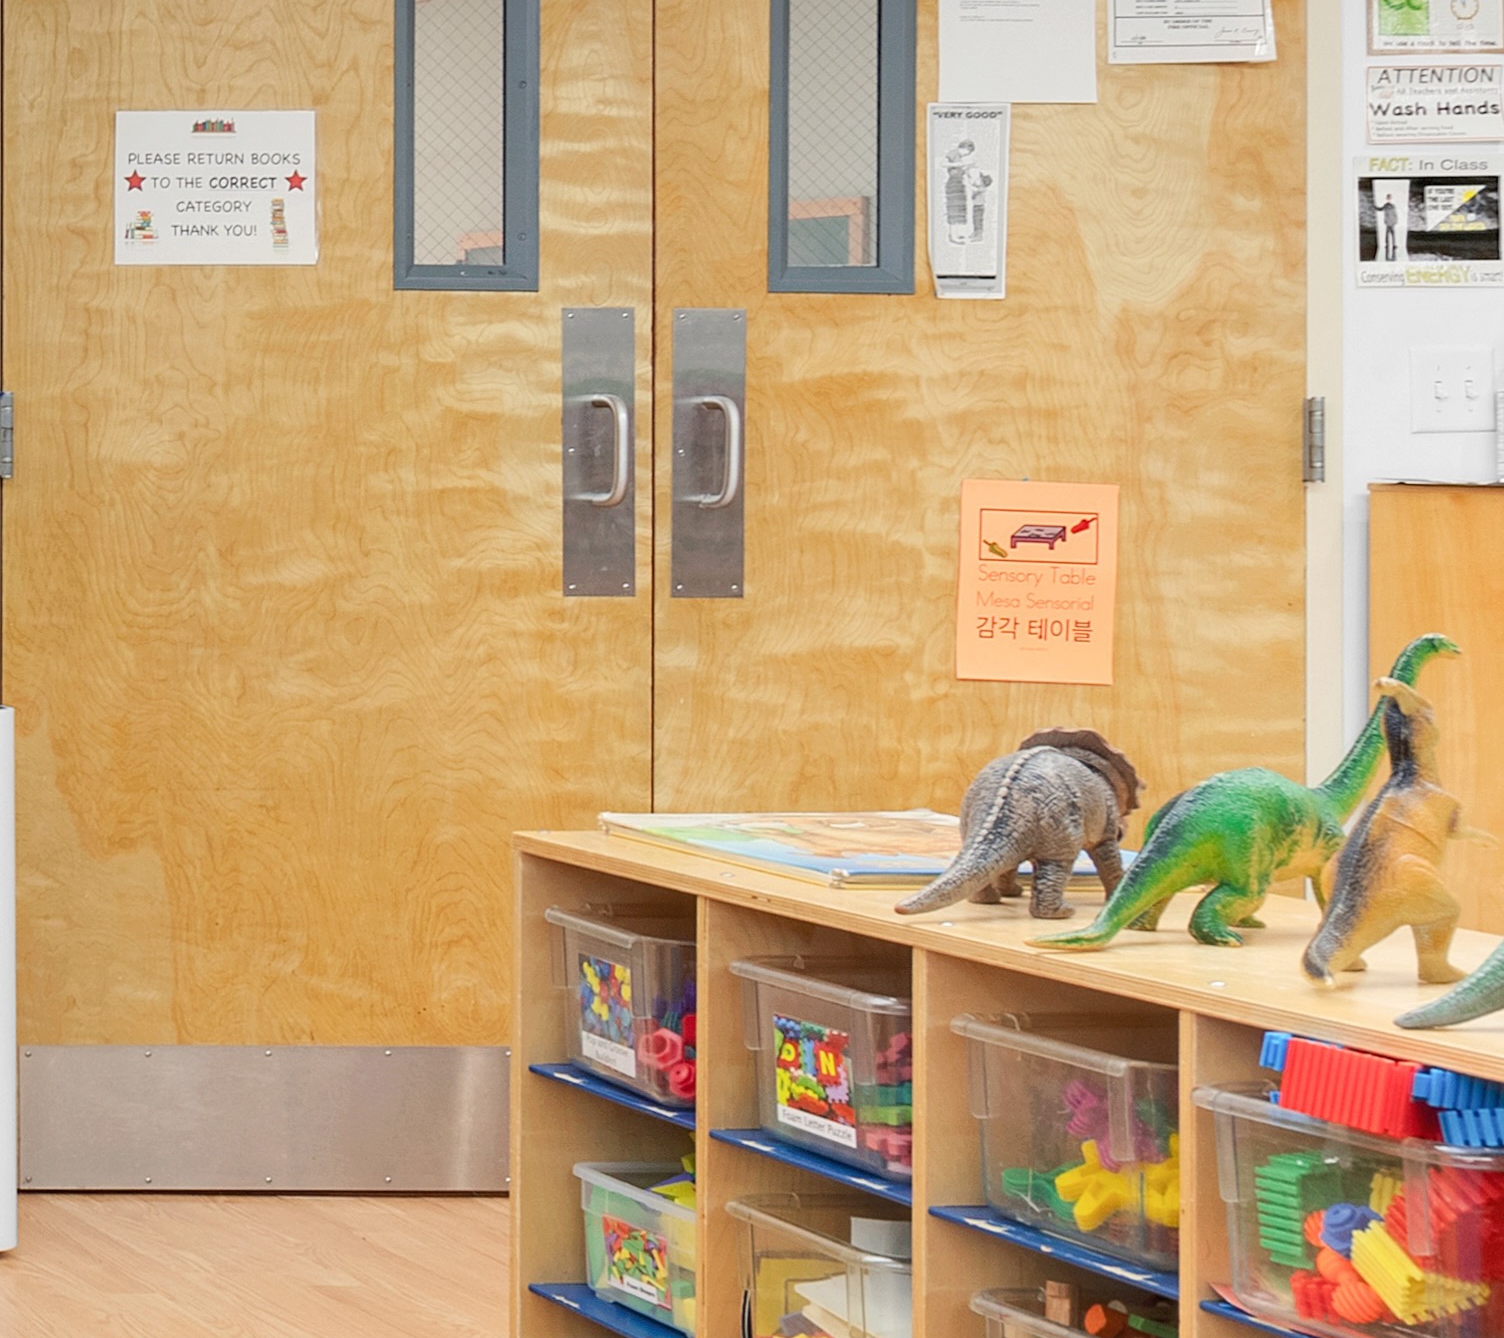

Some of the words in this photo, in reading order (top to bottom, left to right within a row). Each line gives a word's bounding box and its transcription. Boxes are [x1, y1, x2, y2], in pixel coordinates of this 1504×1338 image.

[1377, 68, 1494, 84] ATTENTION
[1369, 101, 1427, 116] Wash
[1437, 100, 1500, 115] Hands
[128, 153, 181, 165] PLEASE
[187, 153, 244, 165] RETURN
[251, 153, 301, 165] BOOKS
[1368, 158, 1412, 172] FACT:
[1419, 160, 1434, 170] In
[1440, 159, 1488, 170] Class
[151, 177, 171, 189] TO
[177, 177, 203, 189] THE
[209, 176, 278, 189] CORRECT
[176, 200, 252, 212] CATEGORY
[171, 225, 218, 237] THANK
[224, 225, 257, 237] YOU!
[1405, 265, 1472, 283] ENERGY
[978, 564, 1043, 586] Sensory
[1051, 566, 1096, 586] Table
[976, 591, 1020, 608] Mesa
[1026, 592, 1094, 611] Sensorial
[976, 616, 1020, 640] 감각
[1028, 618, 1093, 643] 테이블
[782, 1108, 801, 1121] Foam
[804, 1115, 825, 1132] Letter
[827, 1123, 853, 1141] Puzzle
